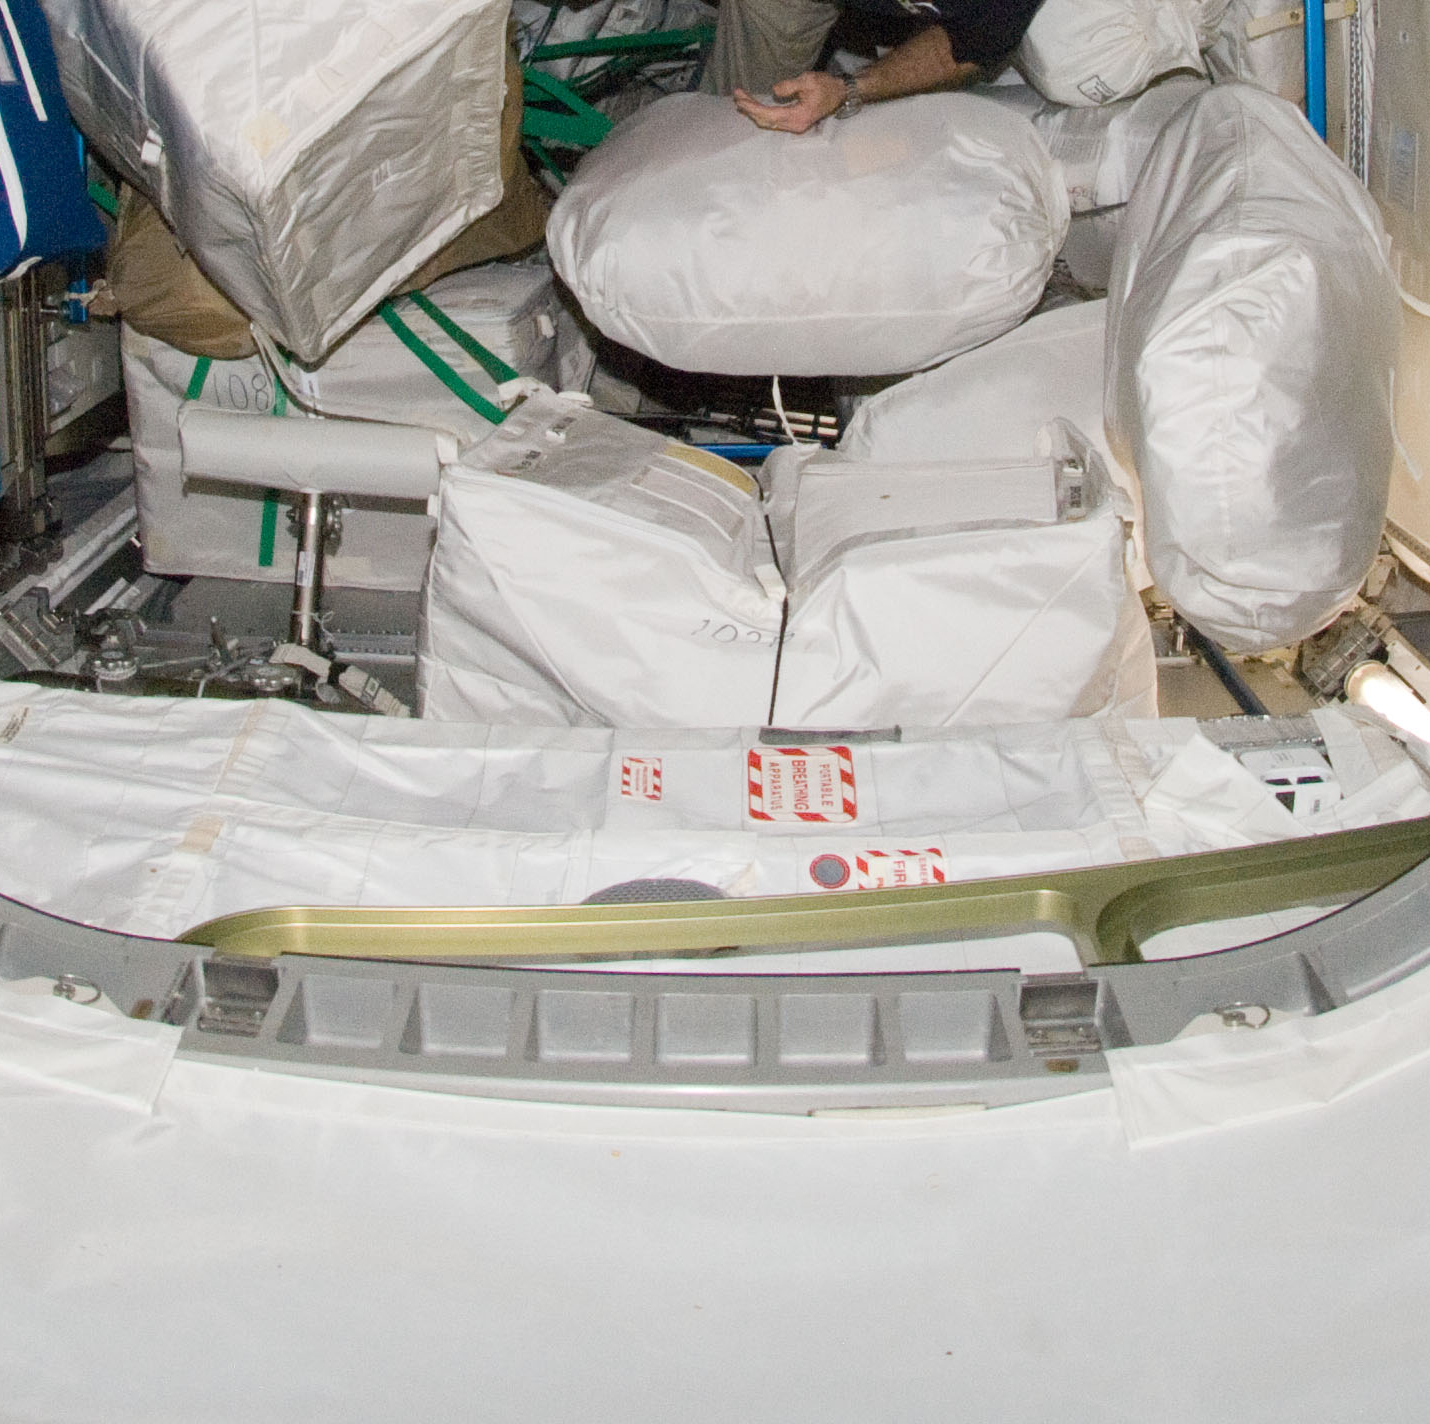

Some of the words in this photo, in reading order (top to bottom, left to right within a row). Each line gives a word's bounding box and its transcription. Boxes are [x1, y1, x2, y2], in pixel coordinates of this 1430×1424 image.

[769, 762, 783, 810] APPARATUS
[792, 760, 809, 810] BREATHING
[819, 764, 834, 807] PORTABLE
